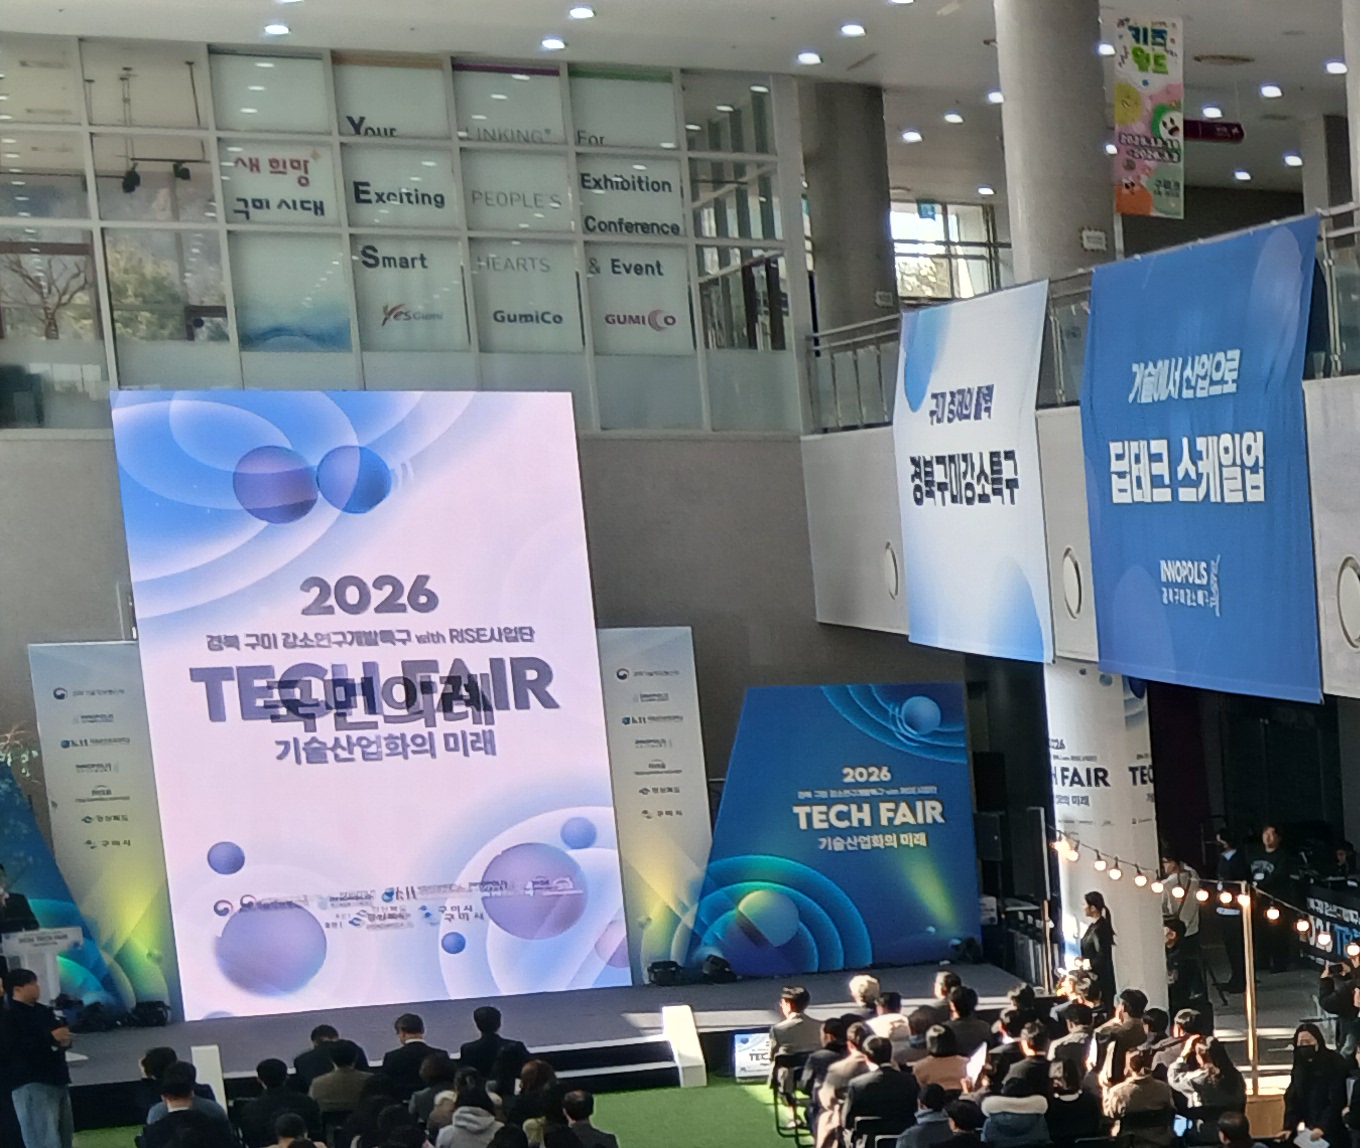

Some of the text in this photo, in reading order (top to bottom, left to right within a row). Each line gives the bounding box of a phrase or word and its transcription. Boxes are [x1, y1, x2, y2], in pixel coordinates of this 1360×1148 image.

[346, 115, 398, 138] Your
[577, 130, 606, 146] For
[234, 156, 310, 188] 새 희망
[581, 173, 673, 194] Exhibition
[353, 181, 446, 209] Exciting
[233, 197, 325, 220] 구미 시대
[585, 216, 681, 236] Conference
[361, 245, 428, 270] Smart
[610, 258, 664, 277] Event
[493, 310, 564, 325] GumiCo
[1181, 348, 1241, 399] 산업으로
[910, 450, 1020, 507] 경북구미강소특구
[1109, 430, 1266, 504] 딥테크 스케일업
[300, 574, 440, 616] 2026
[244, 632, 279, 651] 구미
[275, 728, 498, 766] 기술산업화의 미래
[842, 766, 893, 784] 2026
[1060, 766, 1112, 788] FAIR
[792, 800, 946, 830] TECH FAIR
[899, 831, 928, 848] 미래
